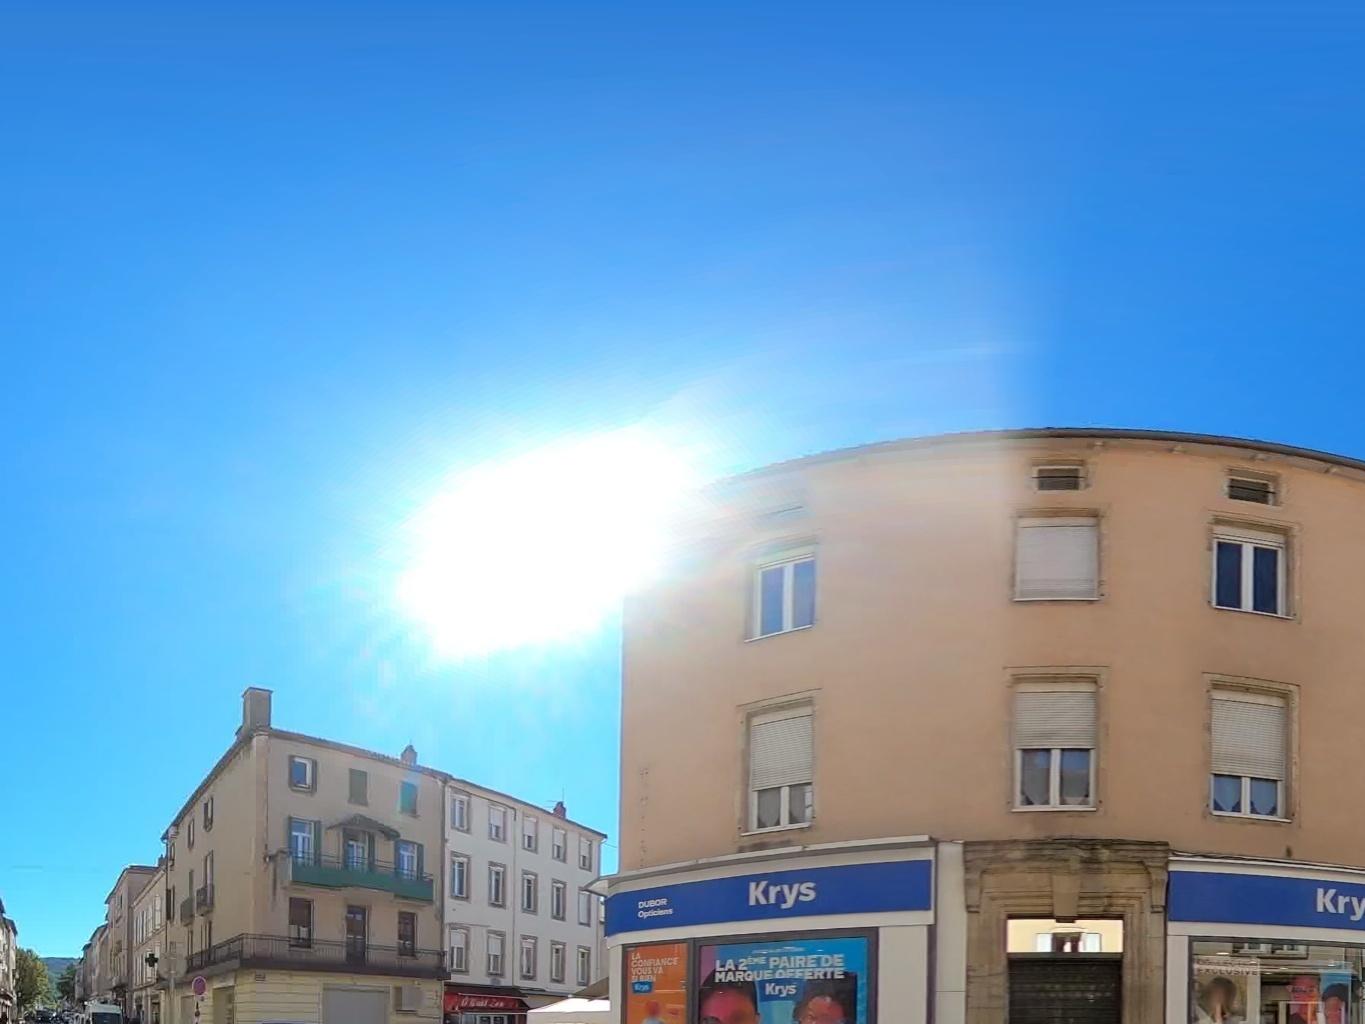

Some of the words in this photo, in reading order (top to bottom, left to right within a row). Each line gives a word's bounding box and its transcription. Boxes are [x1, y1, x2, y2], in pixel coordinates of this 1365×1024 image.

[748, 880, 816, 909] Krys
[638, 898, 668, 909] DUBOR
[637, 908, 673, 919] Opticiens
[631, 952, 641, 960] LA
[631, 957, 679, 968] CONFIANCE
[715, 960, 735, 971] LA
[768, 955, 817, 969] PAIRE
[820, 953, 845, 967] DE
[631, 967, 652, 976] VOUS
[714, 970, 773, 983] MARQUE
[775, 966, 846, 980] OFFERTE
[764, 982, 797, 997] Krys
